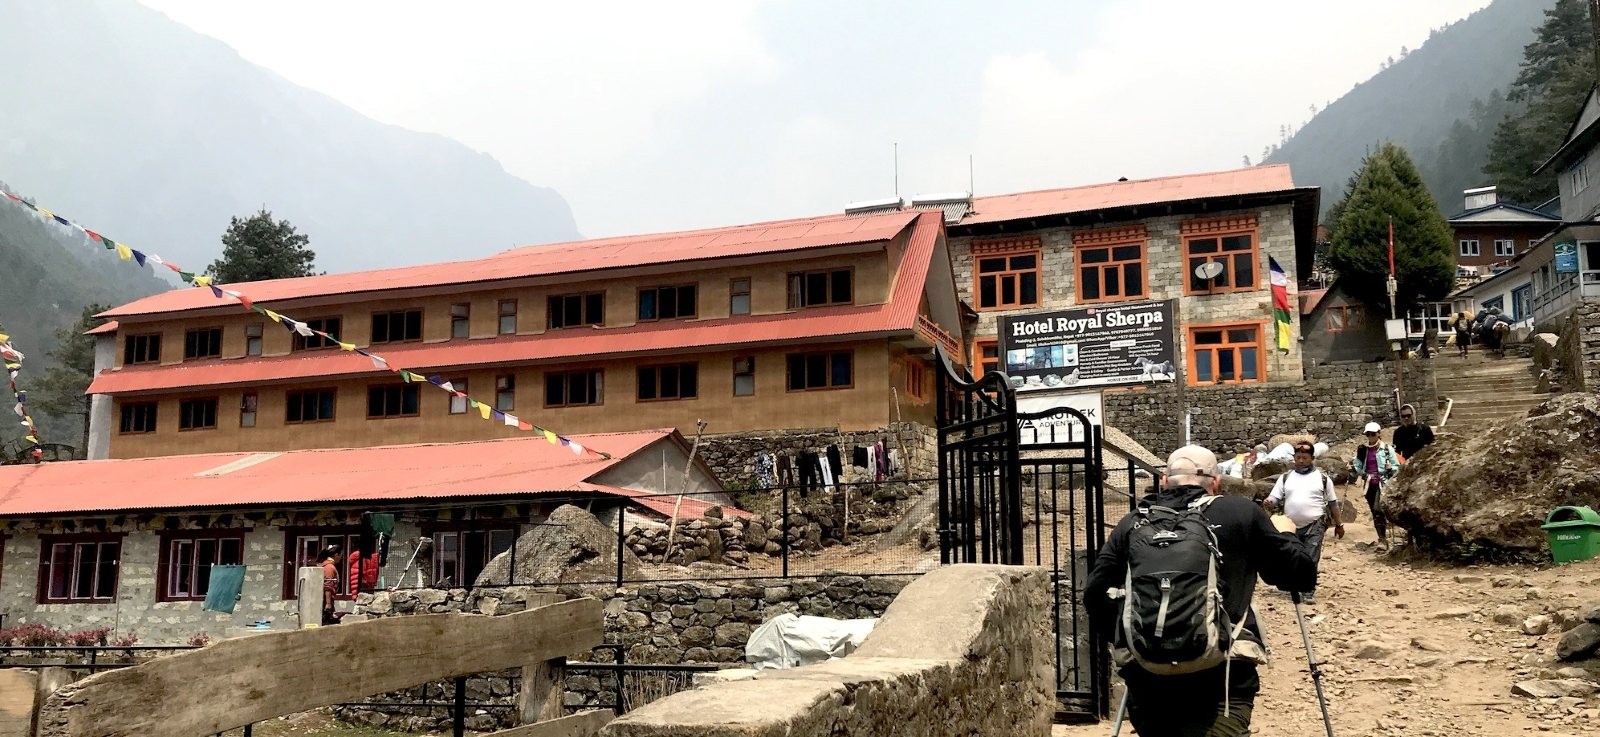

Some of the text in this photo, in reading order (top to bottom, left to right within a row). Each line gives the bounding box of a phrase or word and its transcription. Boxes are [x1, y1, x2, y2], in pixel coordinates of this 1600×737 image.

[1012, 311, 1164, 336] Hotel Royal Sherpa
